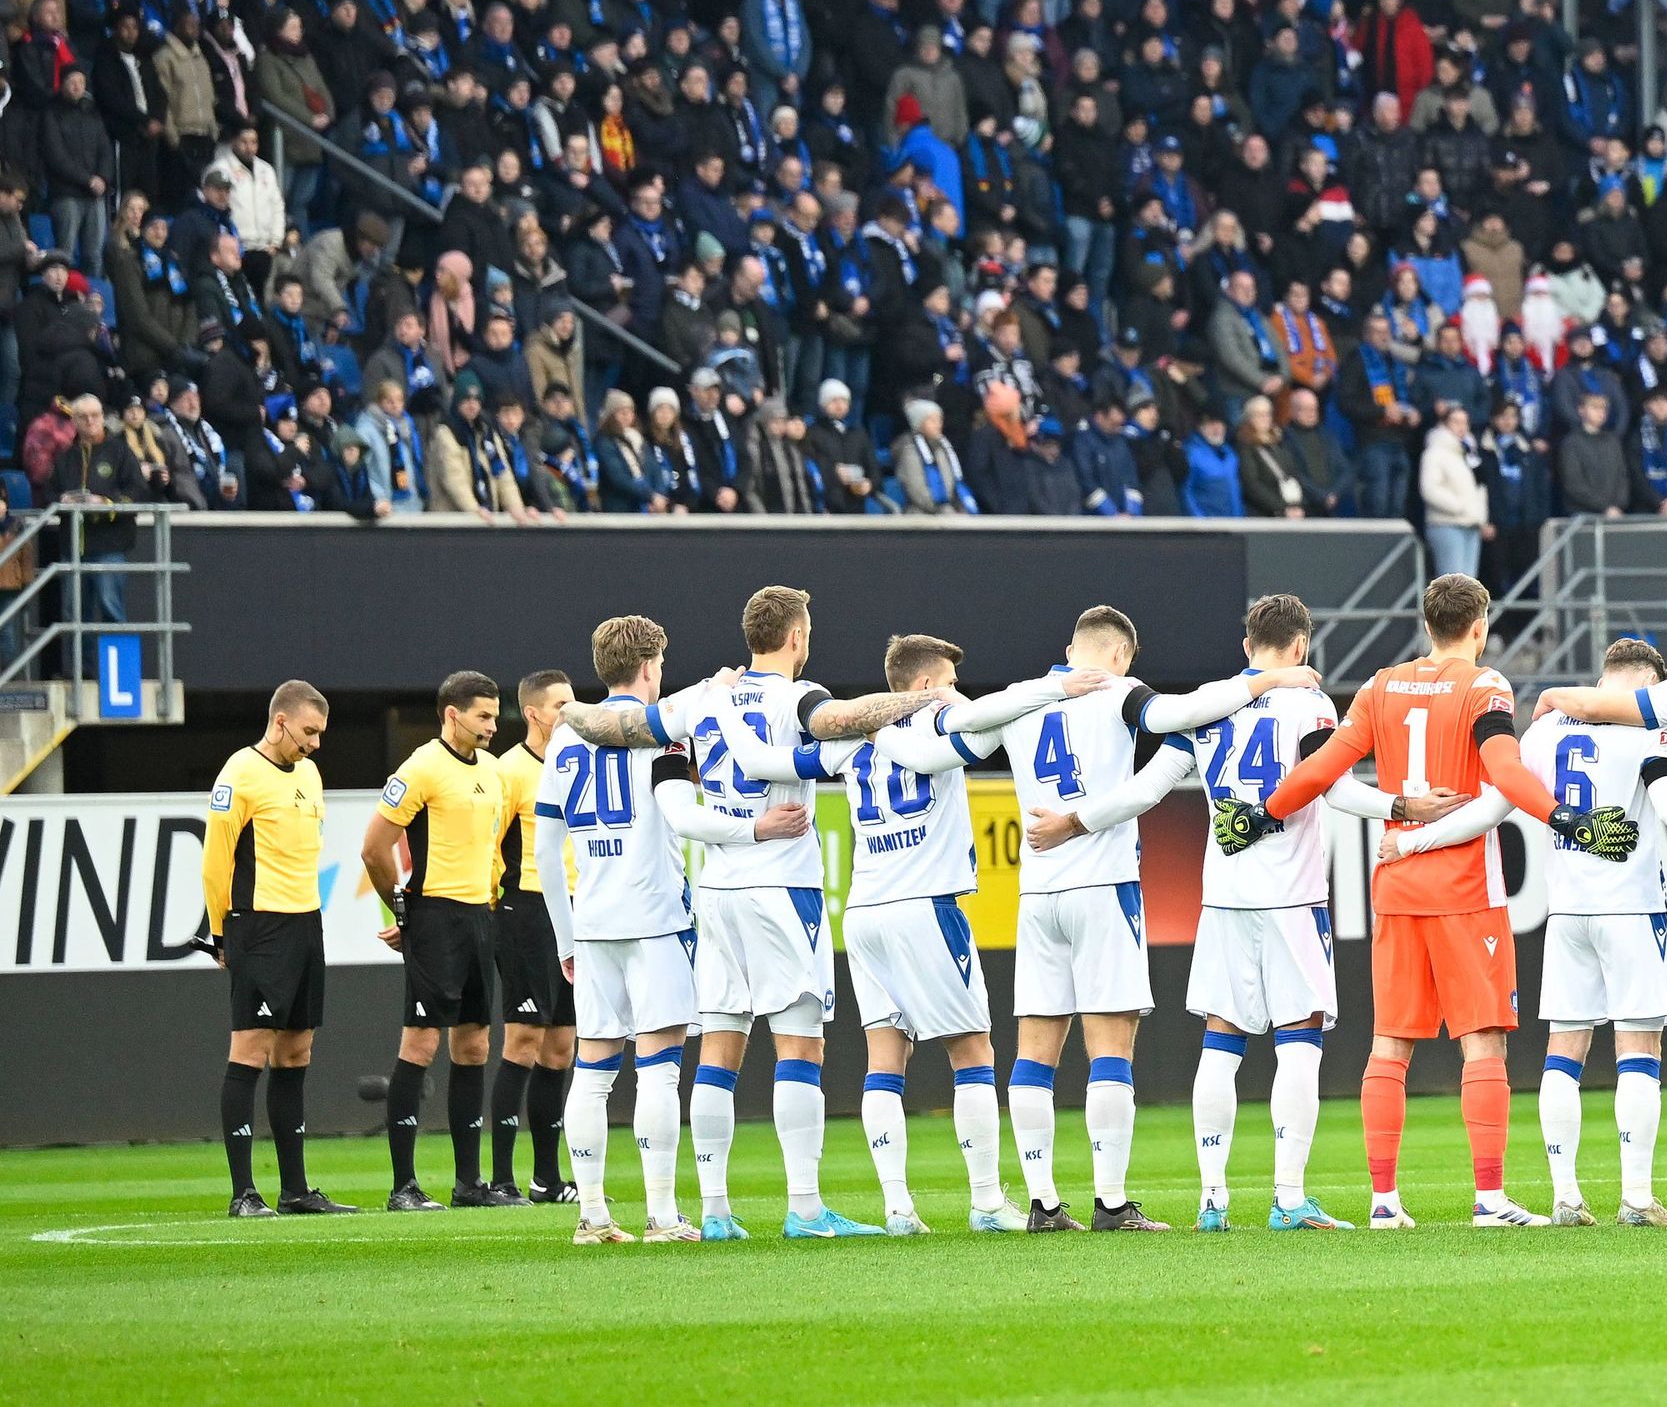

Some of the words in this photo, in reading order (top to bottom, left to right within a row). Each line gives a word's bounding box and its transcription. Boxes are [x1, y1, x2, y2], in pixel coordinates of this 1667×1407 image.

[107, 644, 134, 706] L
[556, 743, 636, 833] 20
[852, 742, 937, 826] 10
[1033, 711, 1086, 801] 4
[1195, 717, 1287, 802] 24
[1403, 707, 1431, 798] 1
[1554, 734, 1600, 814] 6
[587, 838, 623, 857] HOLD
[0, 817, 210, 965] IND
[571, 1147, 592, 1158] KSC
[872, 1132, 890, 1149] KSC
[1025, 1149, 1042, 1161] KSC
[1202, 1133, 1222, 1147] KSC
[1547, 1144, 1562, 1155] KSC
